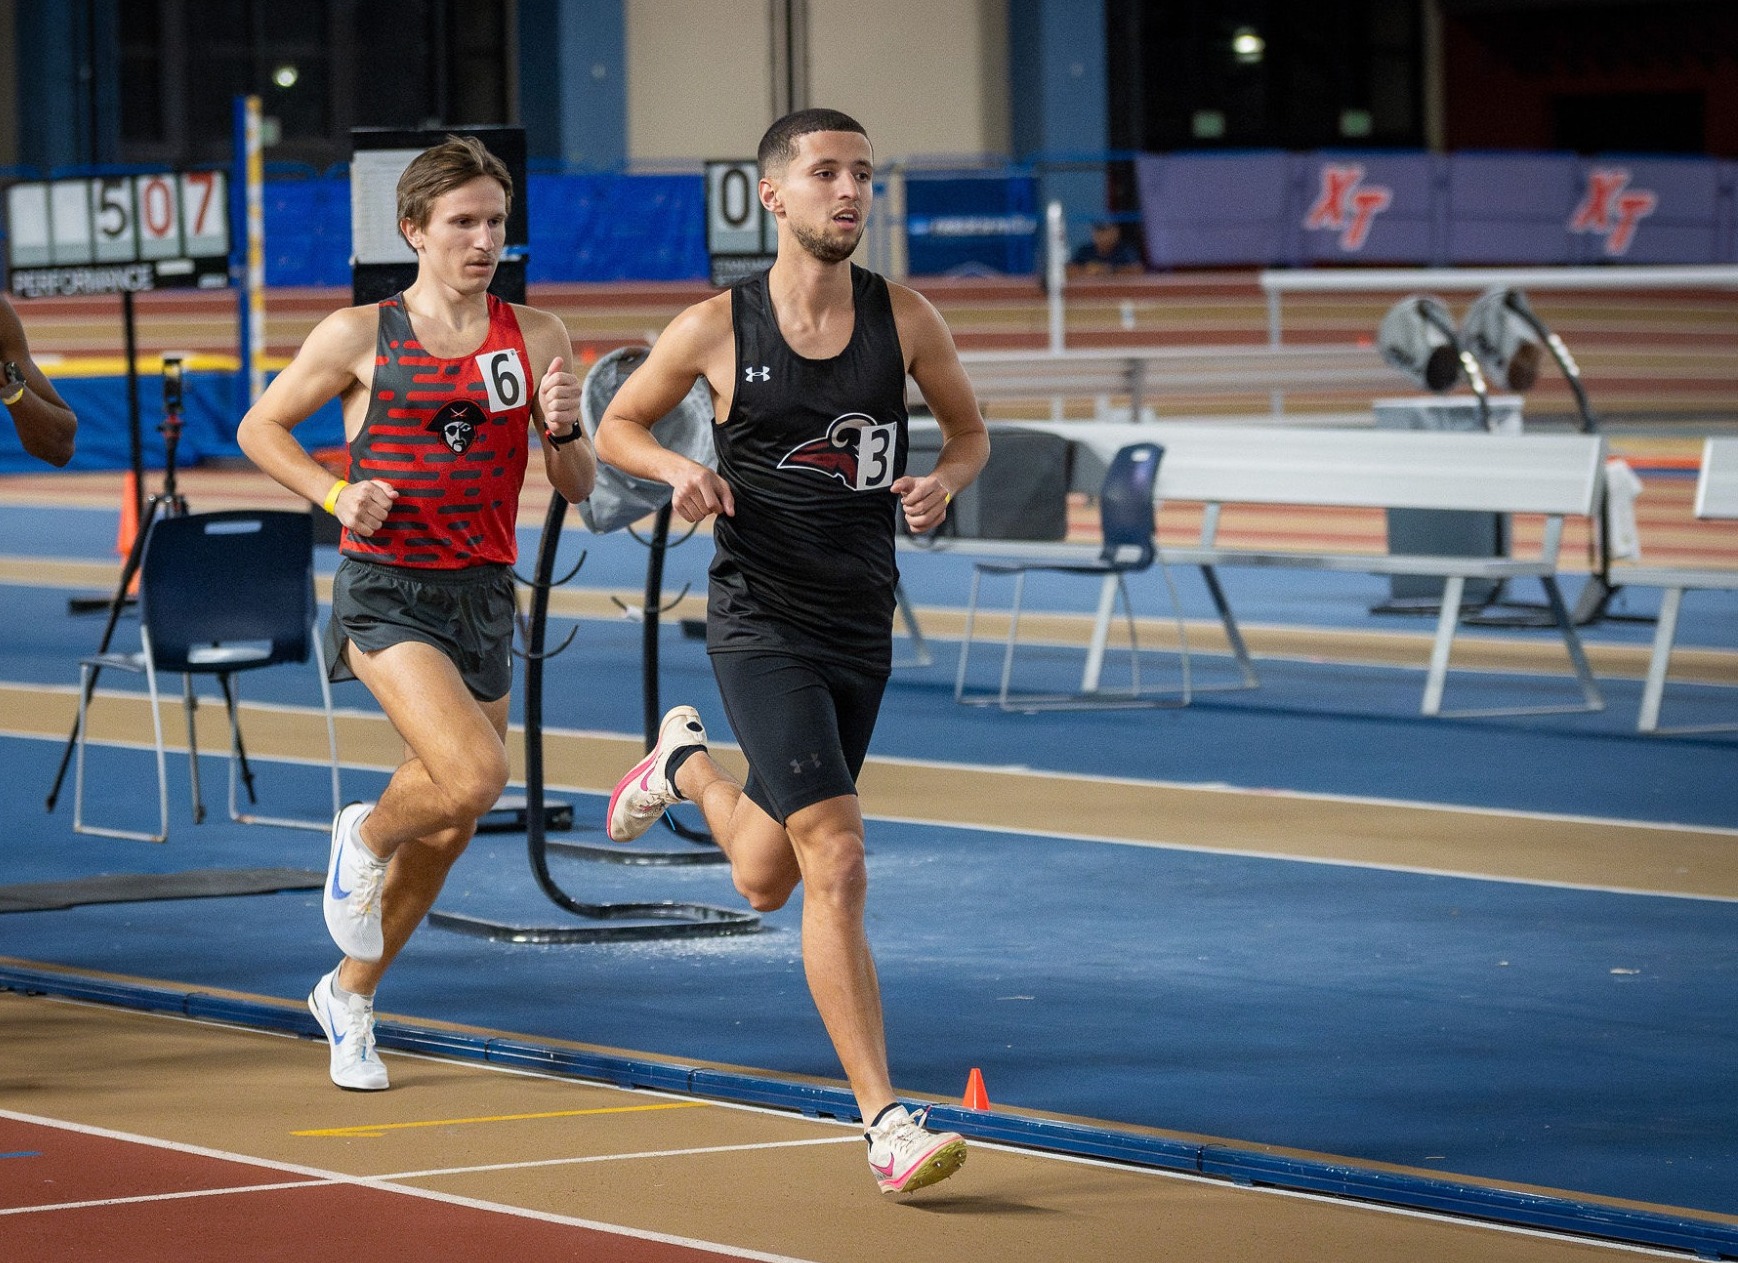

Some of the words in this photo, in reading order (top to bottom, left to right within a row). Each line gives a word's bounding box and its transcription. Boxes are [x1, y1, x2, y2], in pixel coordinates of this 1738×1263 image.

[12, 263, 154, 297] PERFORMANCE
[491, 353, 520, 407] 6
[865, 428, 890, 487] 3
